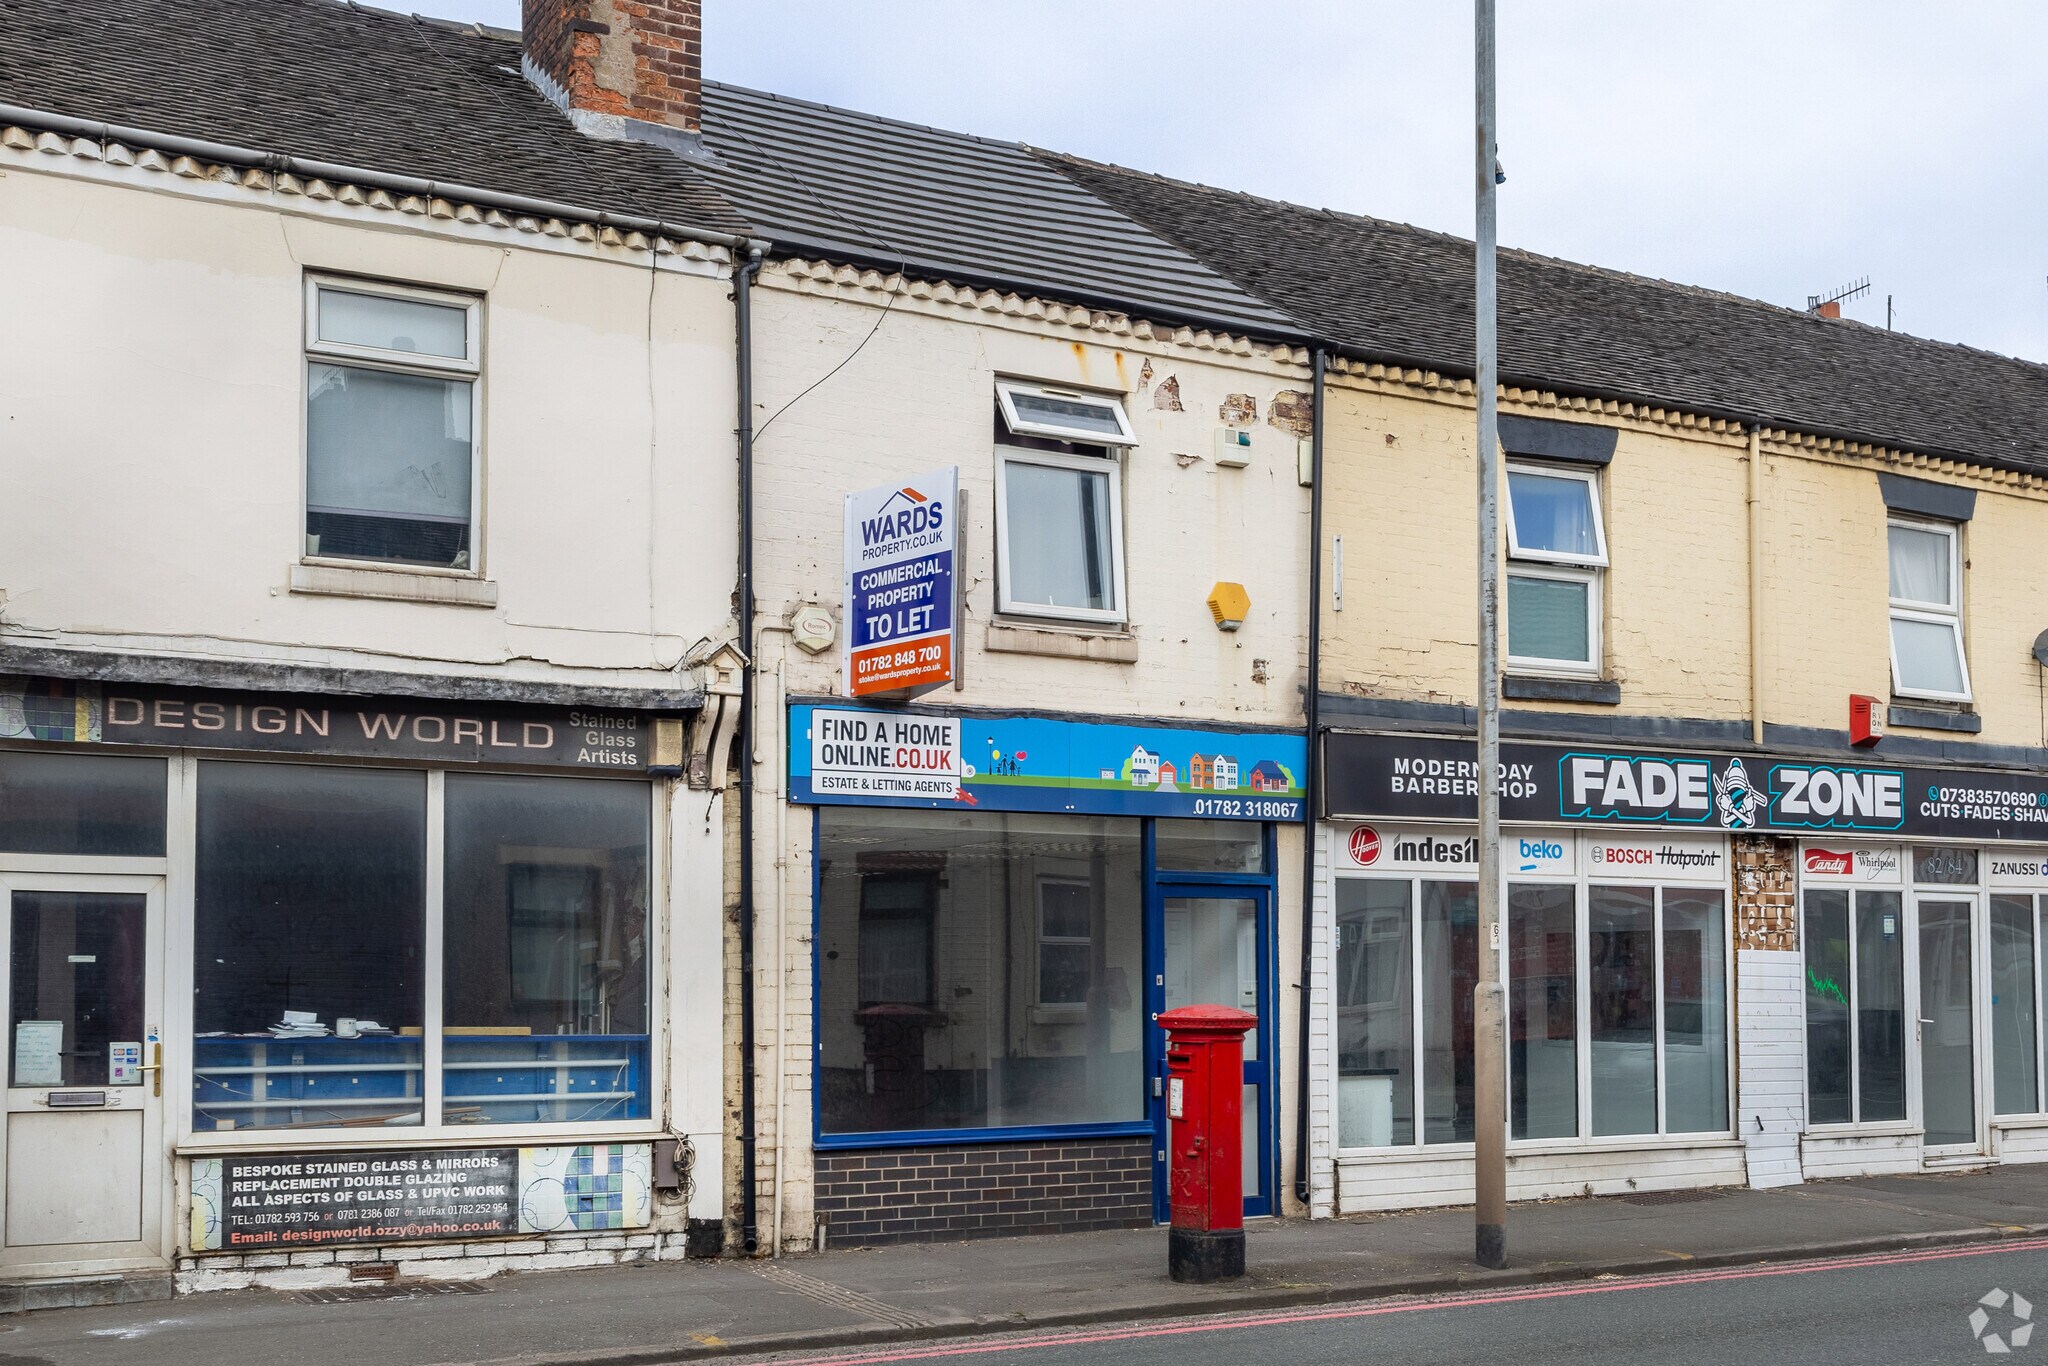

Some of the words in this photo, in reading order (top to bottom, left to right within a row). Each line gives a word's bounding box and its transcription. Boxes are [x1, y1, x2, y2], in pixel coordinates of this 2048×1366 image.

[861, 501, 943, 546] WARDS
[862, 531, 943, 561] PROPERTY.CO.UK
[860, 558, 943, 591] COMMERCIAL
[868, 581, 934, 610] PROPERTY
[866, 613, 893, 640] TO
[897, 604, 935, 634] LET
[858, 655, 892, 674] 01782
[894, 650, 916, 666] 848
[919, 645, 942, 662] 700
[858, 662, 942, 684] stoke@wardsproperty.co.uk
[108, 697, 330, 736] DESIGN
[357, 712, 554, 748] WORLD
[569, 712, 637, 730] Stained
[822, 718, 867, 742] FIND
[875, 722, 888, 743] A
[895, 723, 952, 746] HOME
[585, 731, 636, 748] Glass
[577, 748, 637, 765] Artists
[822, 743, 952, 770] ONLINE.CO.UK
[1498, 763, 1533, 780] DAY
[822, 776, 858, 789] ESTATE
[861, 778, 870, 790] &
[873, 779, 911, 792] LETTING
[914, 781, 952, 793] AGENTS
[1572, 758, 1709, 809] FADE
[1780, 769, 1901, 818] ZONE
[1940, 788, 2037, 807] 07383570690
[1245, 801, 1298, 818] 318067
[1520, 838, 1563, 859] beko
[1606, 848, 1653, 864] BOSCH
[1656, 846, 1721, 870] Hotpoint
[1805, 855, 1848, 874] Candy
[1858, 857, 1896, 870] Whirlpool
[1928, 857, 1962, 874] 82/84
[1992, 862, 2039, 875] ZANUSSI
[233, 1165, 302, 1177] BESPOKE
[305, 1162, 368, 1175] STAINED
[371, 1160, 417, 1173] GLASS
[421, 1159, 432, 1170] &
[436, 1157, 499, 1169] MIRRORS
[233, 1179, 340, 1192] REPLACEMENT
[344, 1175, 401, 1188] DOUBLE
[405, 1172, 467, 1186] GLAZING
[232, 1195, 260, 1207] ALL
[264, 1192, 330, 1206] ASPECTS
[334, 1192, 353, 1203] OF
[357, 1189, 403, 1202] GLASS
[408, 1188, 418, 1199] &
[422, 1186, 459, 1199] UPVC
[463, 1184, 505, 1196] WORK
[232, 1215, 253, 1226] TEL:
[255, 1213, 283, 1225] 01782
[284, 1212, 301, 1223] 593
[303, 1211, 319, 1222] 756
[324, 1213, 333, 1221] or
[337, 1210, 358, 1220] 0781
[361, 1209, 382, 1219] 2386
[384, 1208, 400, 1218] 087
[404, 1209, 413, 1217] or
[417, 1205, 446, 1217] Tel/Fax
[448, 1204, 473, 1215] 01782
[474, 1203, 491, 1214] 252
[492, 1202, 508, 1213] 954
[231, 1230, 278, 1244] Email:
[282, 1219, 501, 1242] designworld.ozzy@yahoo.co.uk
